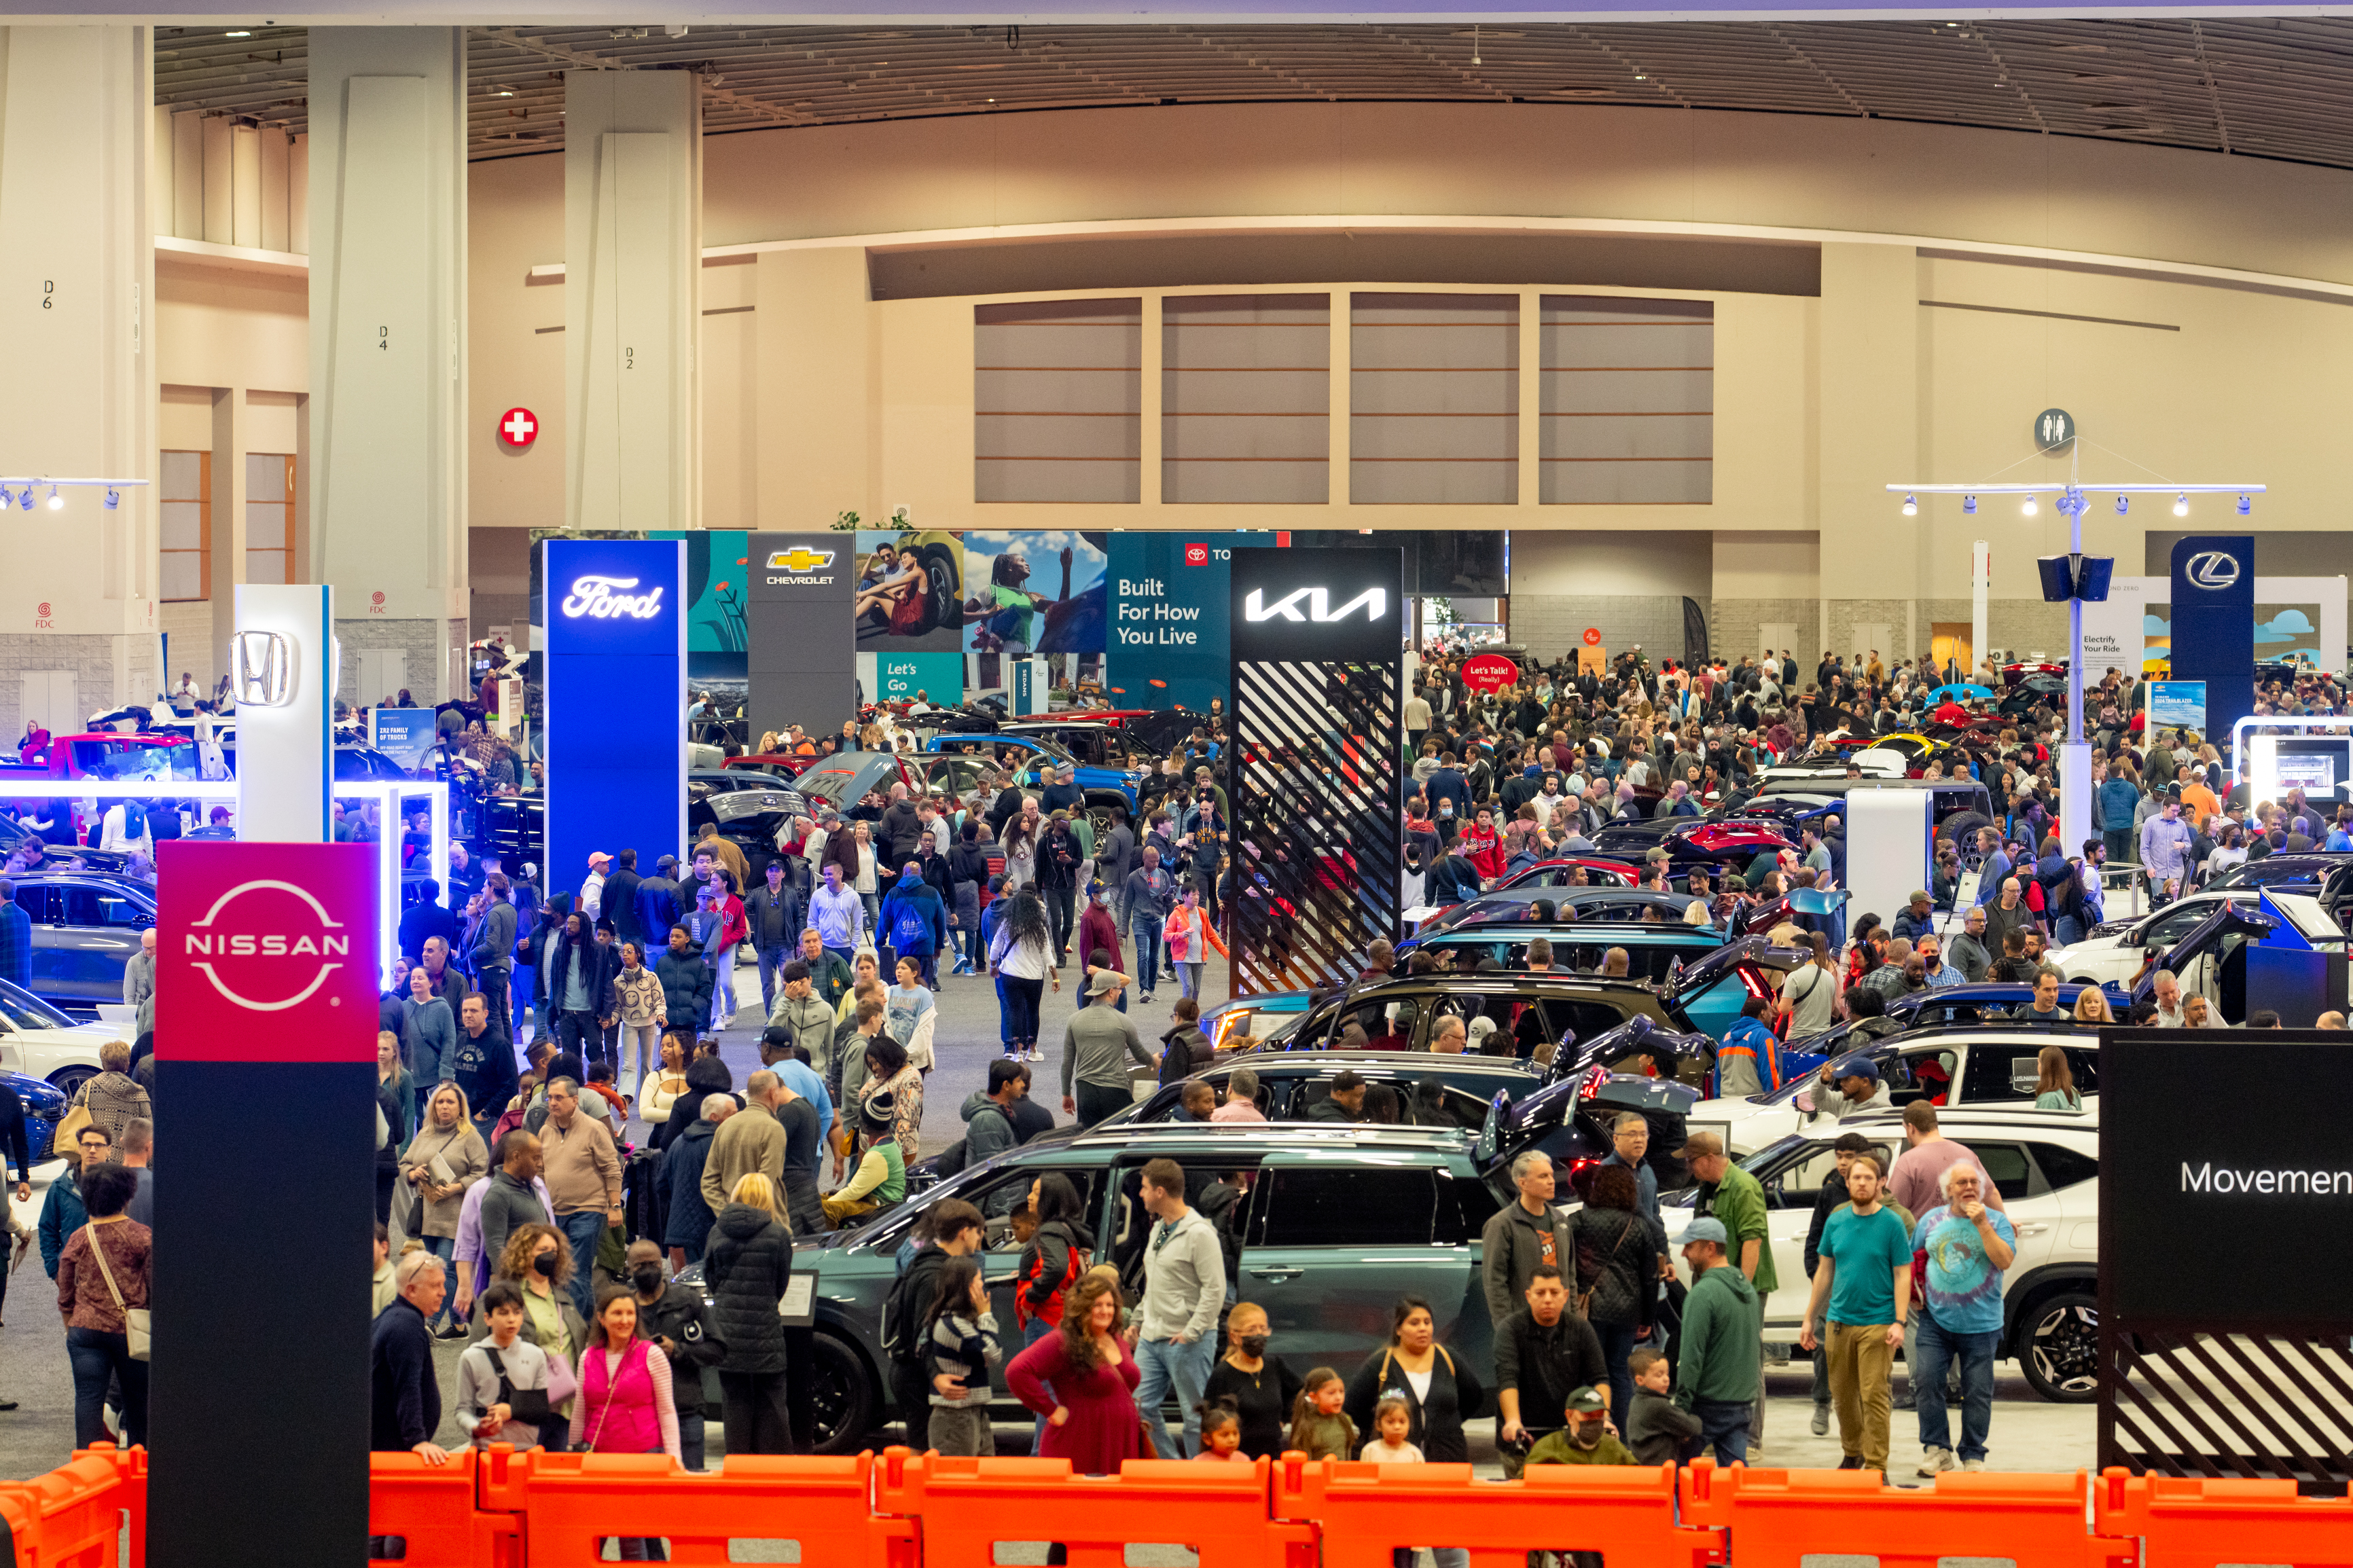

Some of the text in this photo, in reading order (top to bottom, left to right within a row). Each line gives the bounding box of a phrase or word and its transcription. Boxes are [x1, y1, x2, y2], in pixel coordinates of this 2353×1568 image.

[44, 280, 54, 293] D
[43, 296, 52, 309] 6
[380, 326, 388, 338] D
[379, 340, 388, 351] 4
[626, 347, 633, 357] D
[626, 359, 633, 369] 2
[766, 577, 835, 585] CHEVROLET
[1119, 579, 1164, 596] Built
[562, 575, 663, 619] Ford
[370, 606, 387, 614] FDC
[1119, 603, 1200, 620] For How
[35, 619, 54, 629] FDC
[1117, 627, 1198, 644] You Live
[2084, 636, 2115, 644] Electrify
[887, 663, 916, 675] Let's
[1471, 666, 1508, 675] Let's Talk!
[888, 679, 908, 691] Go
[185, 934, 349, 956] NISSAN
[2181, 1162, 2353, 1195] Movemen
